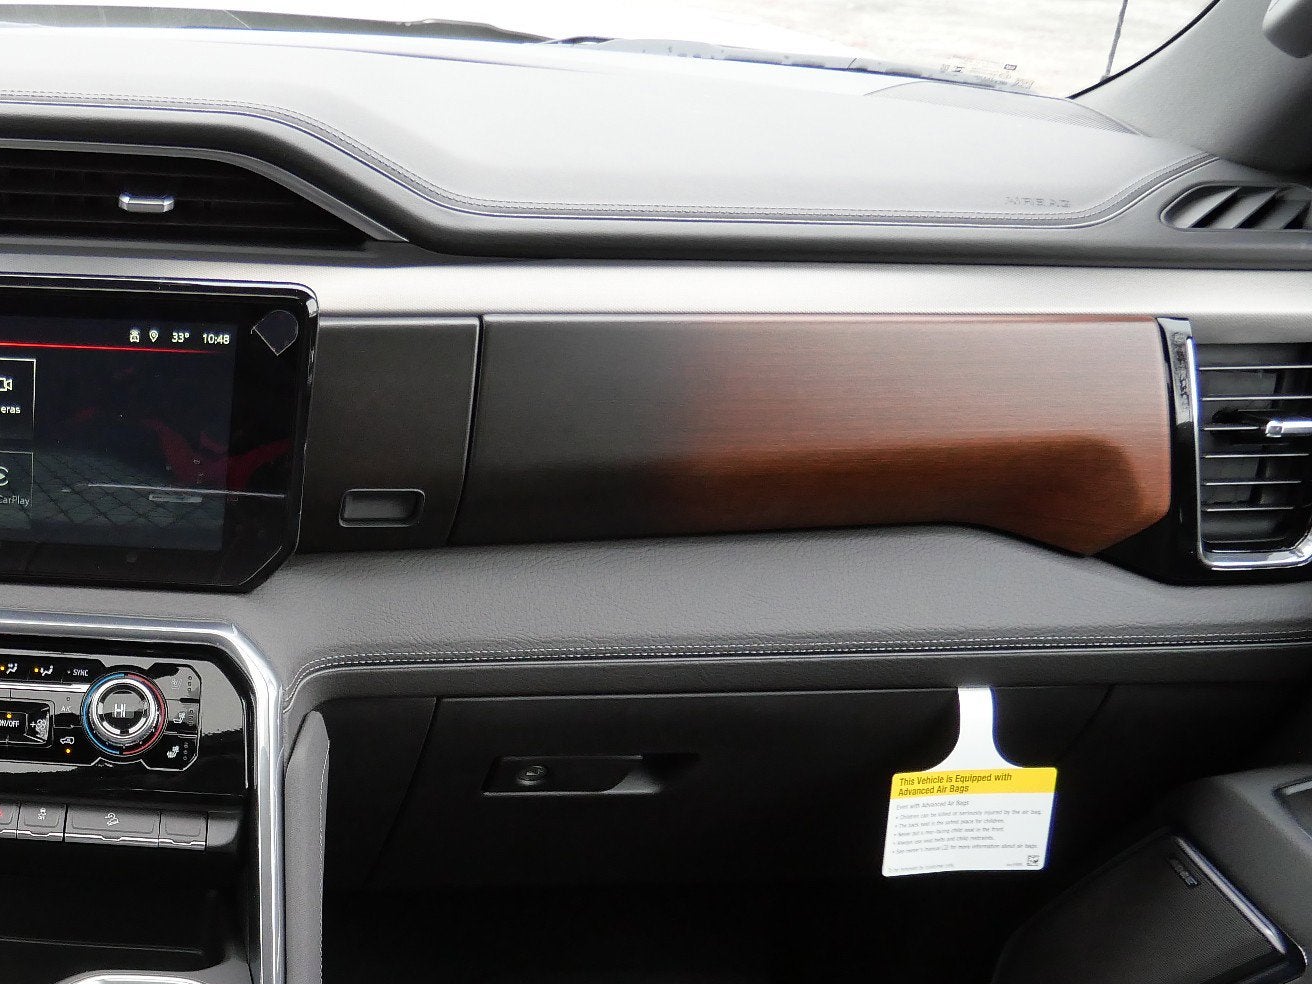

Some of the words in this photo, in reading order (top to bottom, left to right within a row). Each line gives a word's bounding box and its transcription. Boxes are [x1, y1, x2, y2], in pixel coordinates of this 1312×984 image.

[202, 332, 230, 345] 10:48
[72, 668, 88, 677] SYNC
[114, 704, 126, 718] HI
[899, 778, 915, 786] This
[917, 776, 944, 784] Vehicle
[955, 774, 992, 784] Equipped
[994, 773, 1012, 781] with
[898, 787, 934, 796] Advanced
[936, 786, 948, 794] Air
[949, 785, 969, 794] Bags
